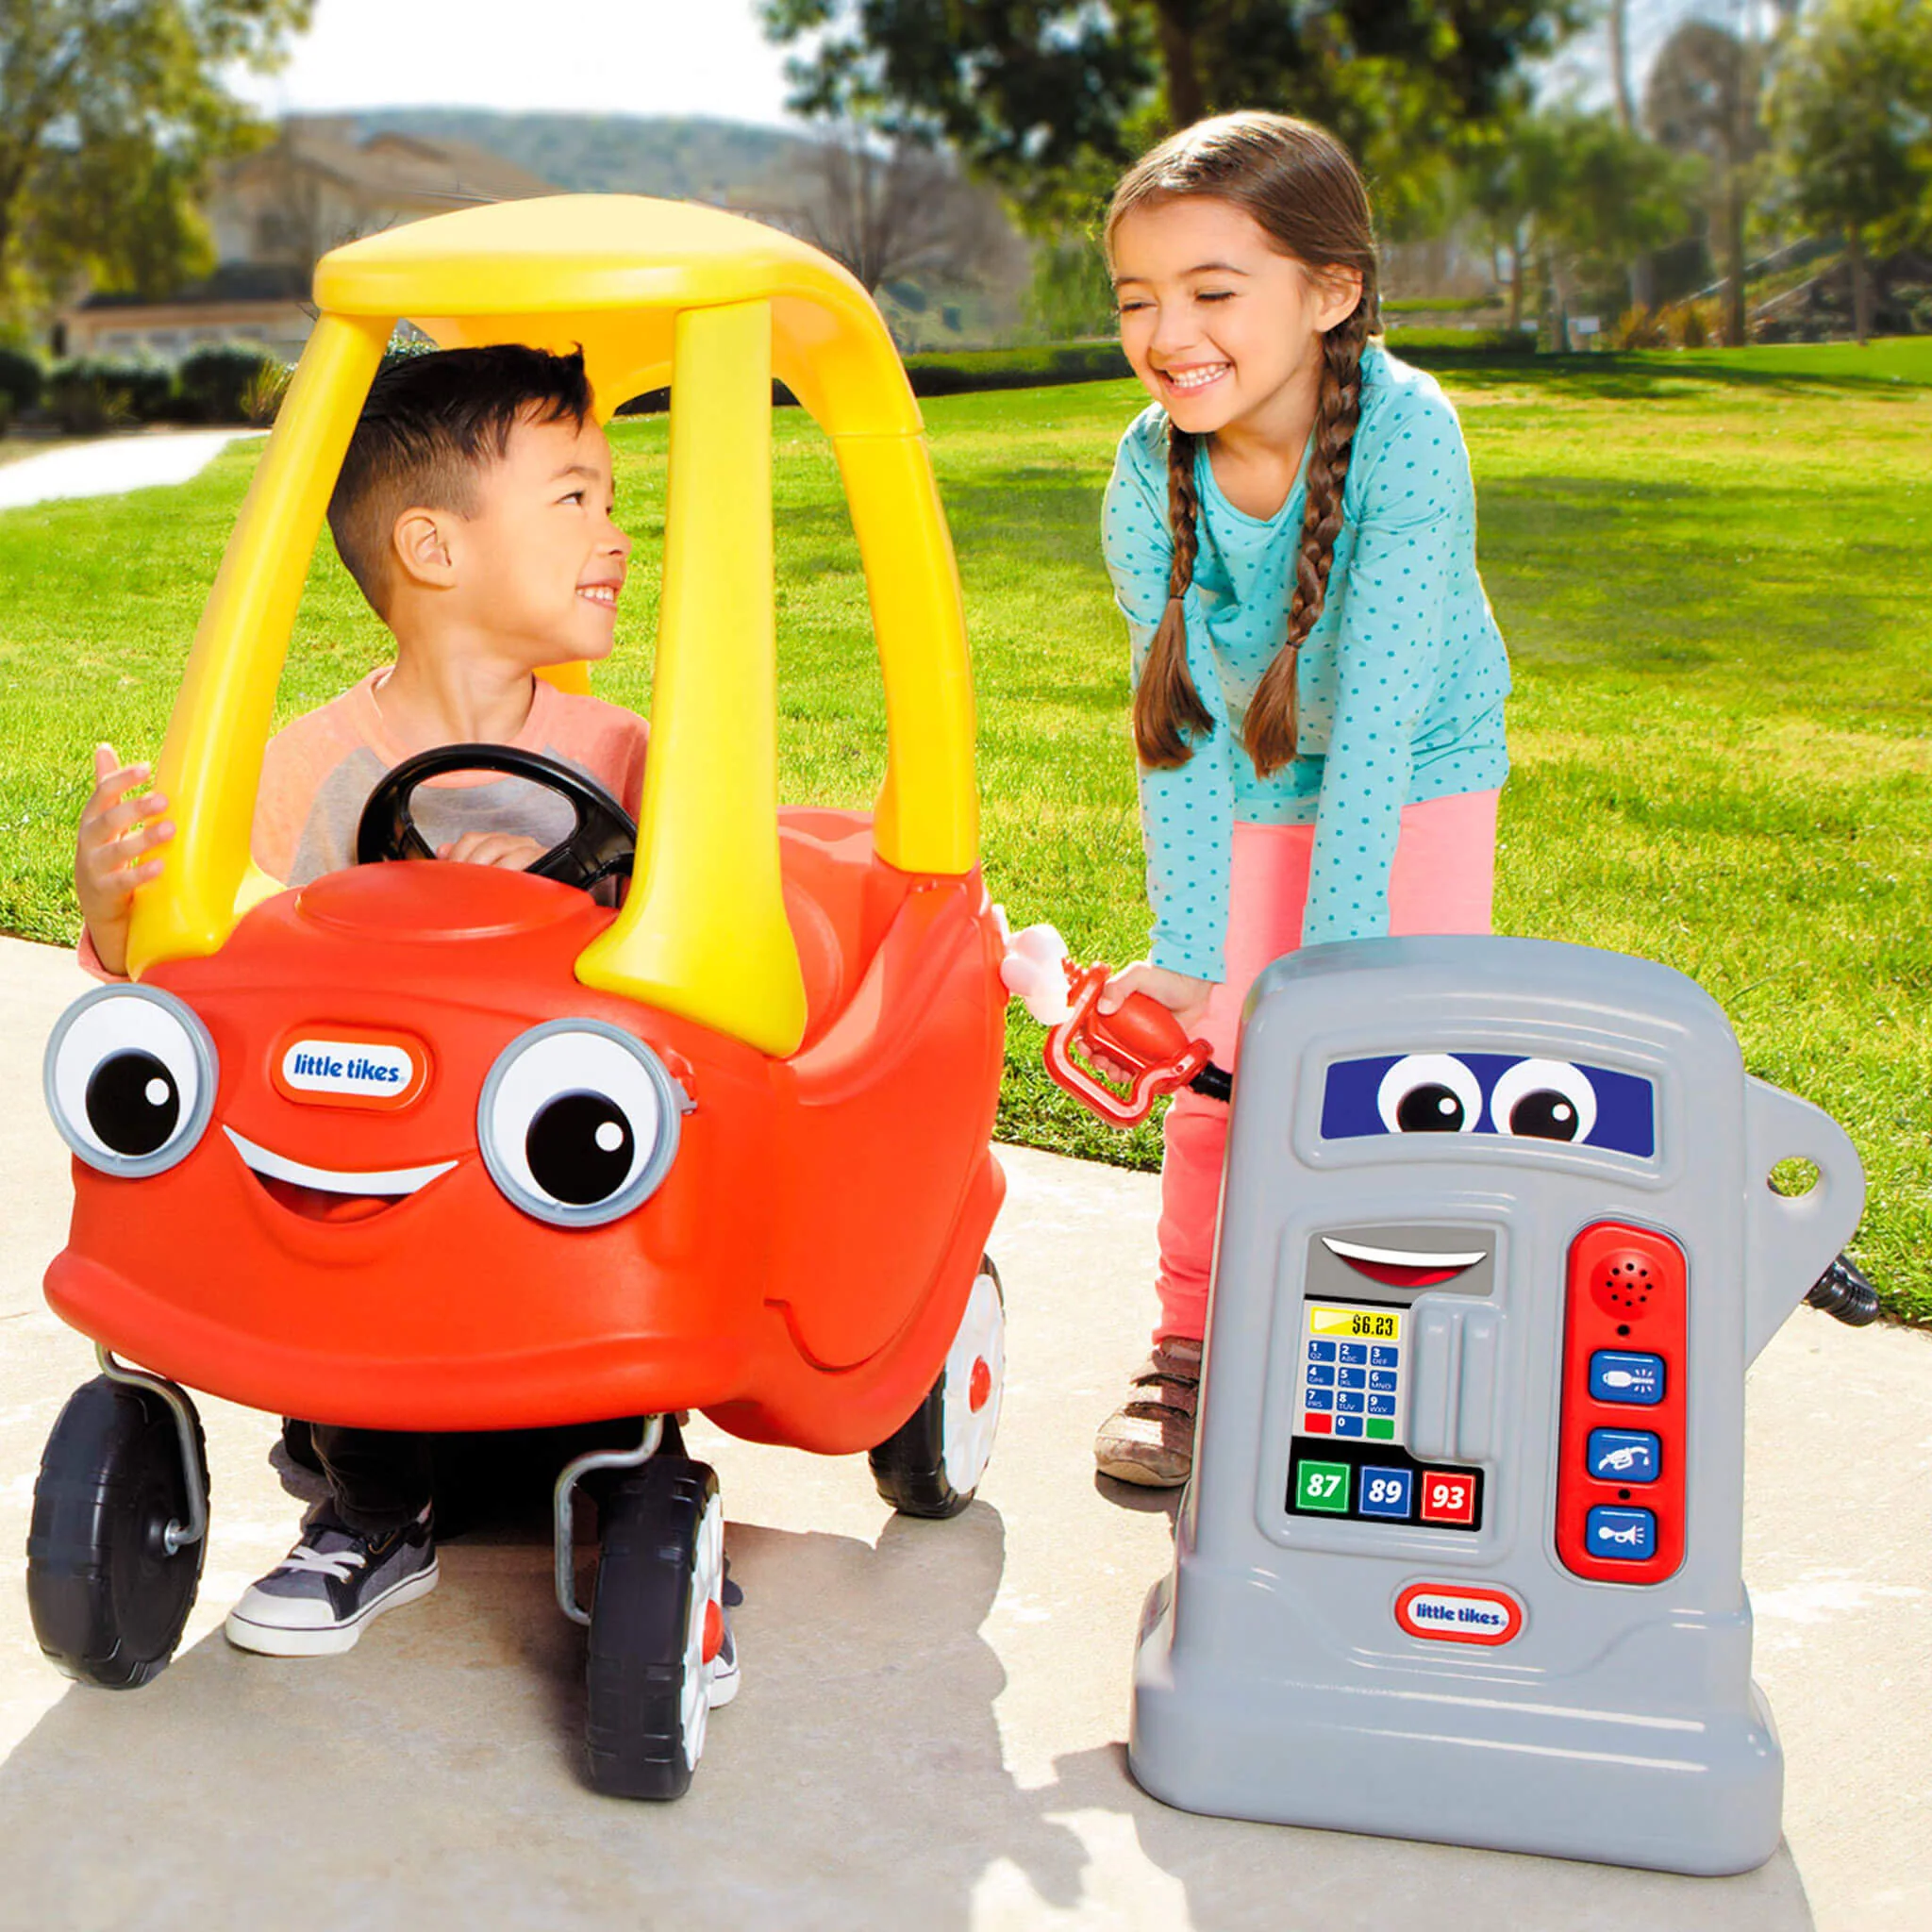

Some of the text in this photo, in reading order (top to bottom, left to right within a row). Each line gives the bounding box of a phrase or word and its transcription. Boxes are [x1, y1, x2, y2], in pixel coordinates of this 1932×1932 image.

[294, 1054, 399, 1082] little tikes
[1352, 1313, 1393, 1336] $6.23
[1311, 1342, 1318, 1351] 1
[1341, 1345, 1350, 1355] 2
[1373, 1348, 1380, 1357] 3
[1309, 1367, 1317, 1375] 4
[1340, 1369, 1348, 1378] 5
[1372, 1372, 1379, 1381] 6
[1307, 1391, 1316, 1400] 7
[1339, 1393, 1347, 1403] 8
[1370, 1396, 1378, 1406] 9
[1338, 1418, 1345, 1426] 0
[1307, 1474, 1465, 1509] 87 89 93
[1416, 1603, 1500, 1625] little tikes
